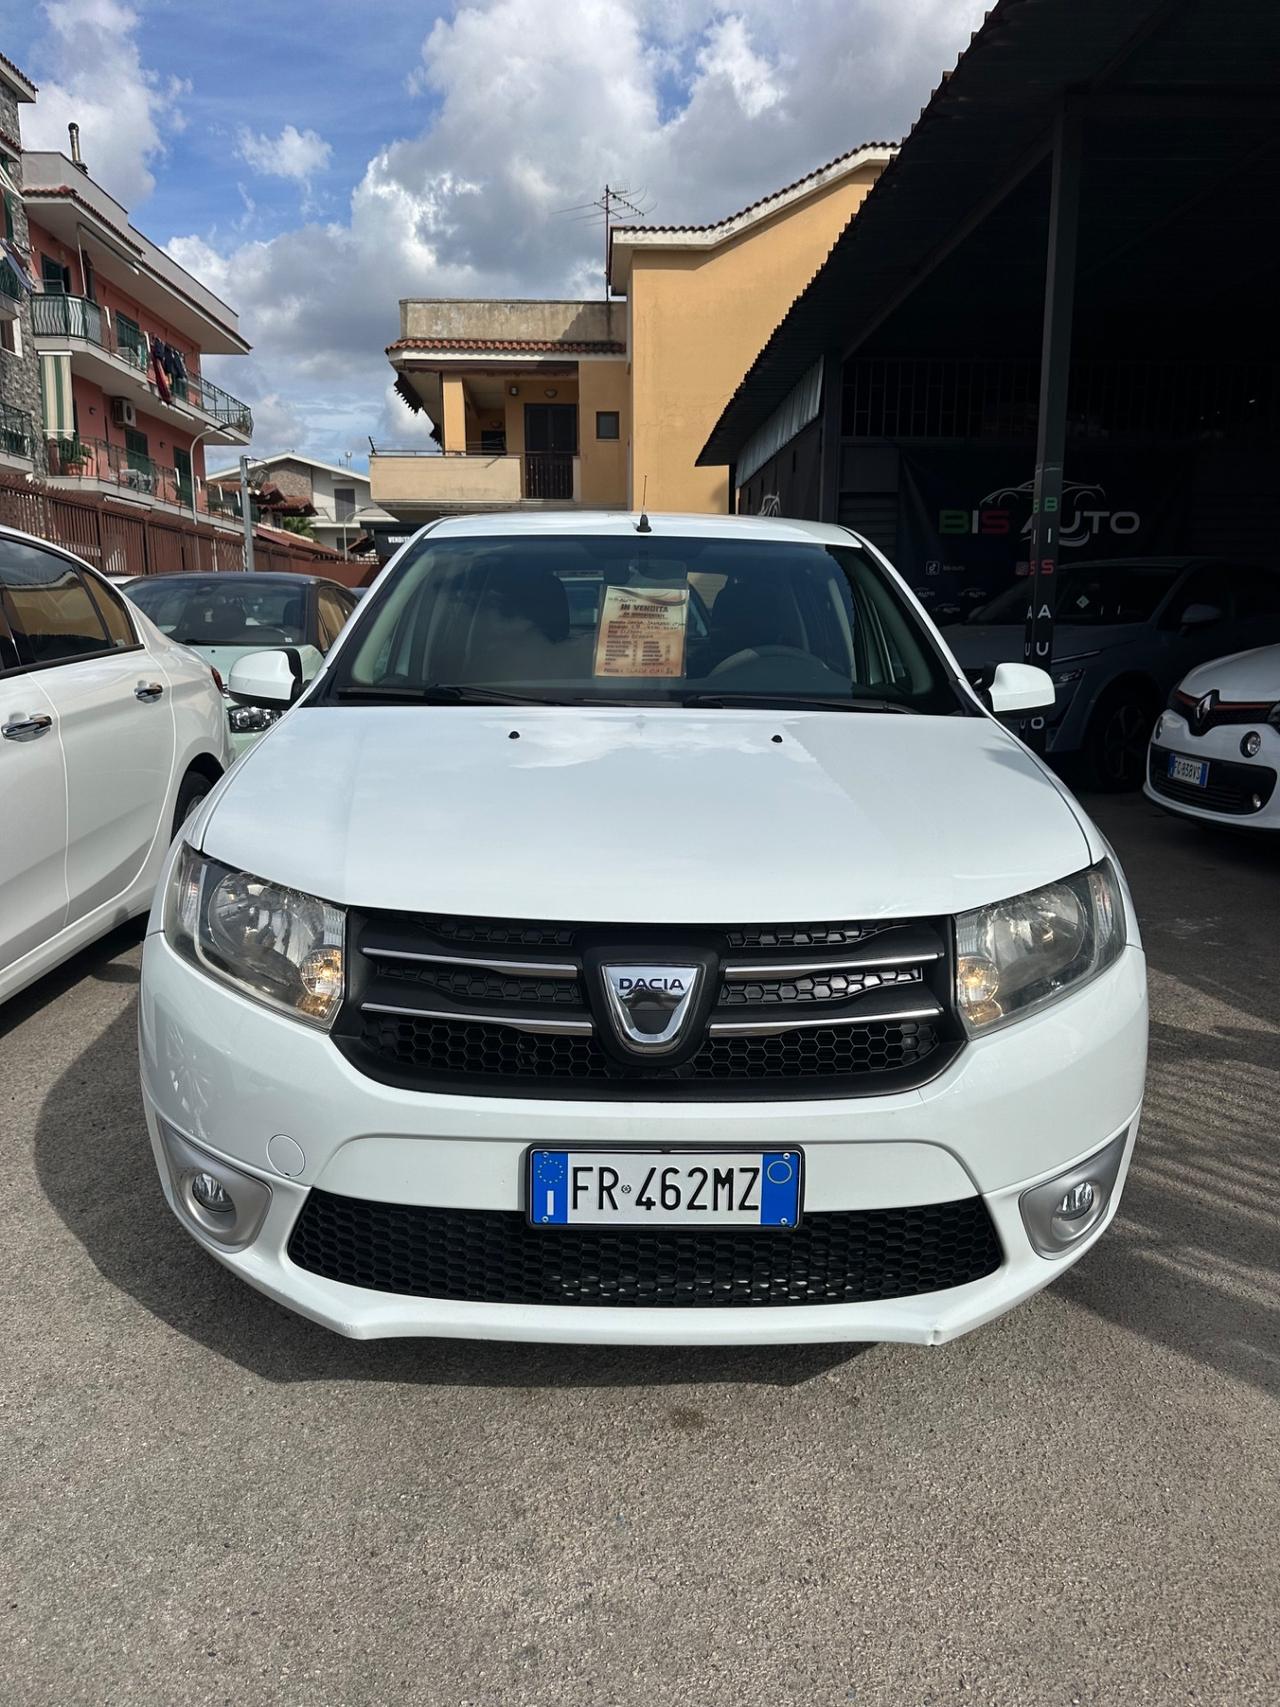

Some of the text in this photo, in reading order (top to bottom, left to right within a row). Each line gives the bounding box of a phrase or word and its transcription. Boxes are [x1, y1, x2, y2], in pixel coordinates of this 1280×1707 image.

[940, 510, 1010, 534] BIS
[633, 604, 669, 613] VENDITA
[619, 978, 684, 991] DACIA
[571, 1166, 761, 1212] FR 462MZ
